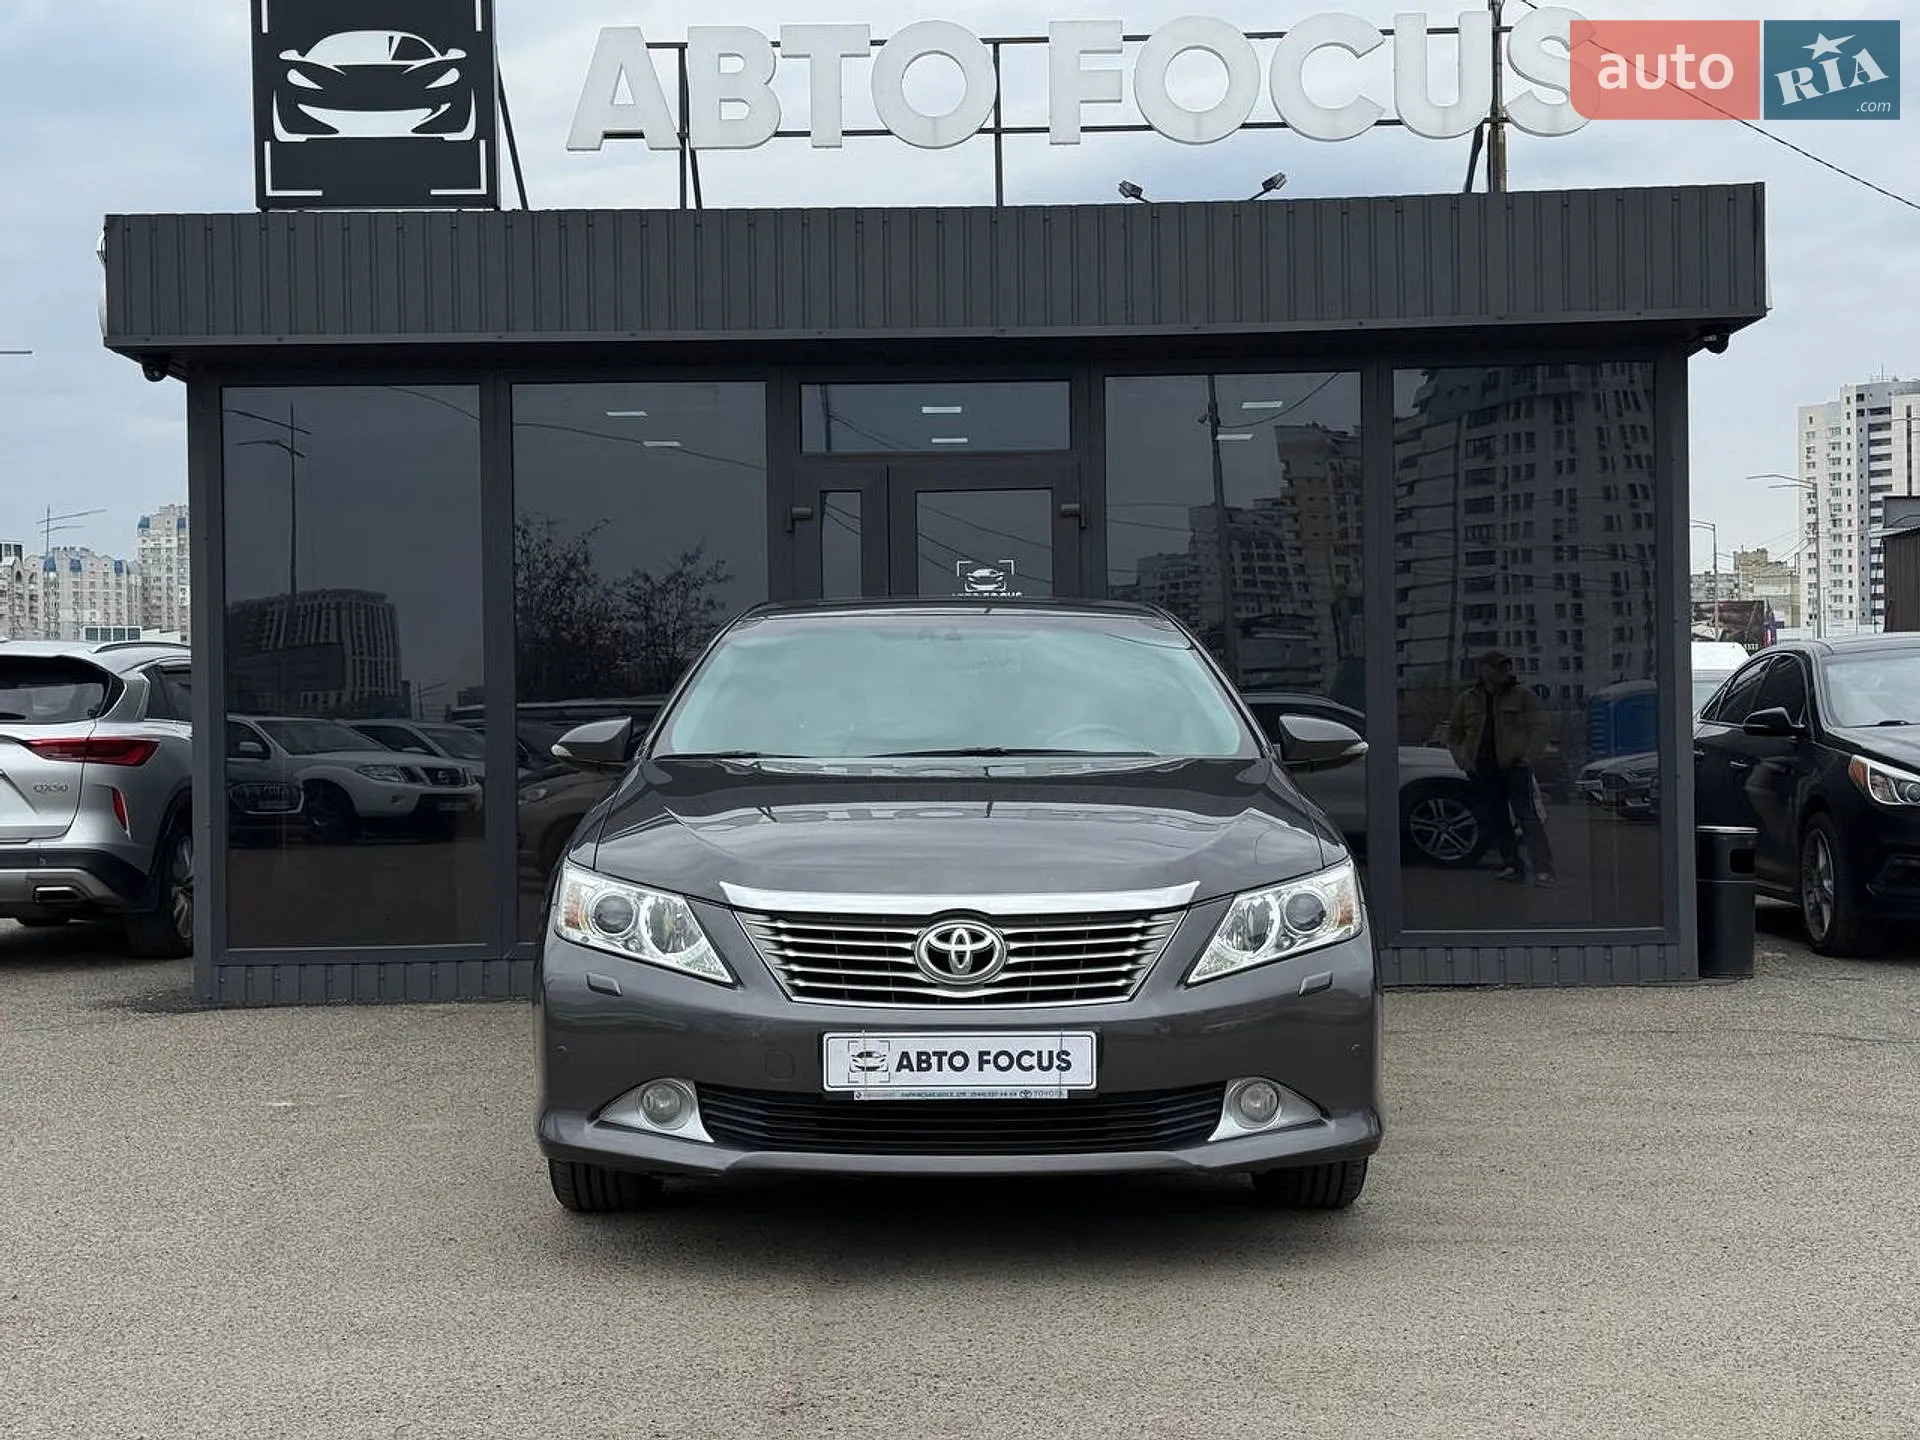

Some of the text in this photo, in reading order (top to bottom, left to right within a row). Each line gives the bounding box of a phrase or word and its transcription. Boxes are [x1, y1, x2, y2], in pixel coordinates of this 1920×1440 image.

[566, 6, 1601, 150] АВТО FOCUS
[895, 1050, 1073, 1072] АВТО FOCUS
